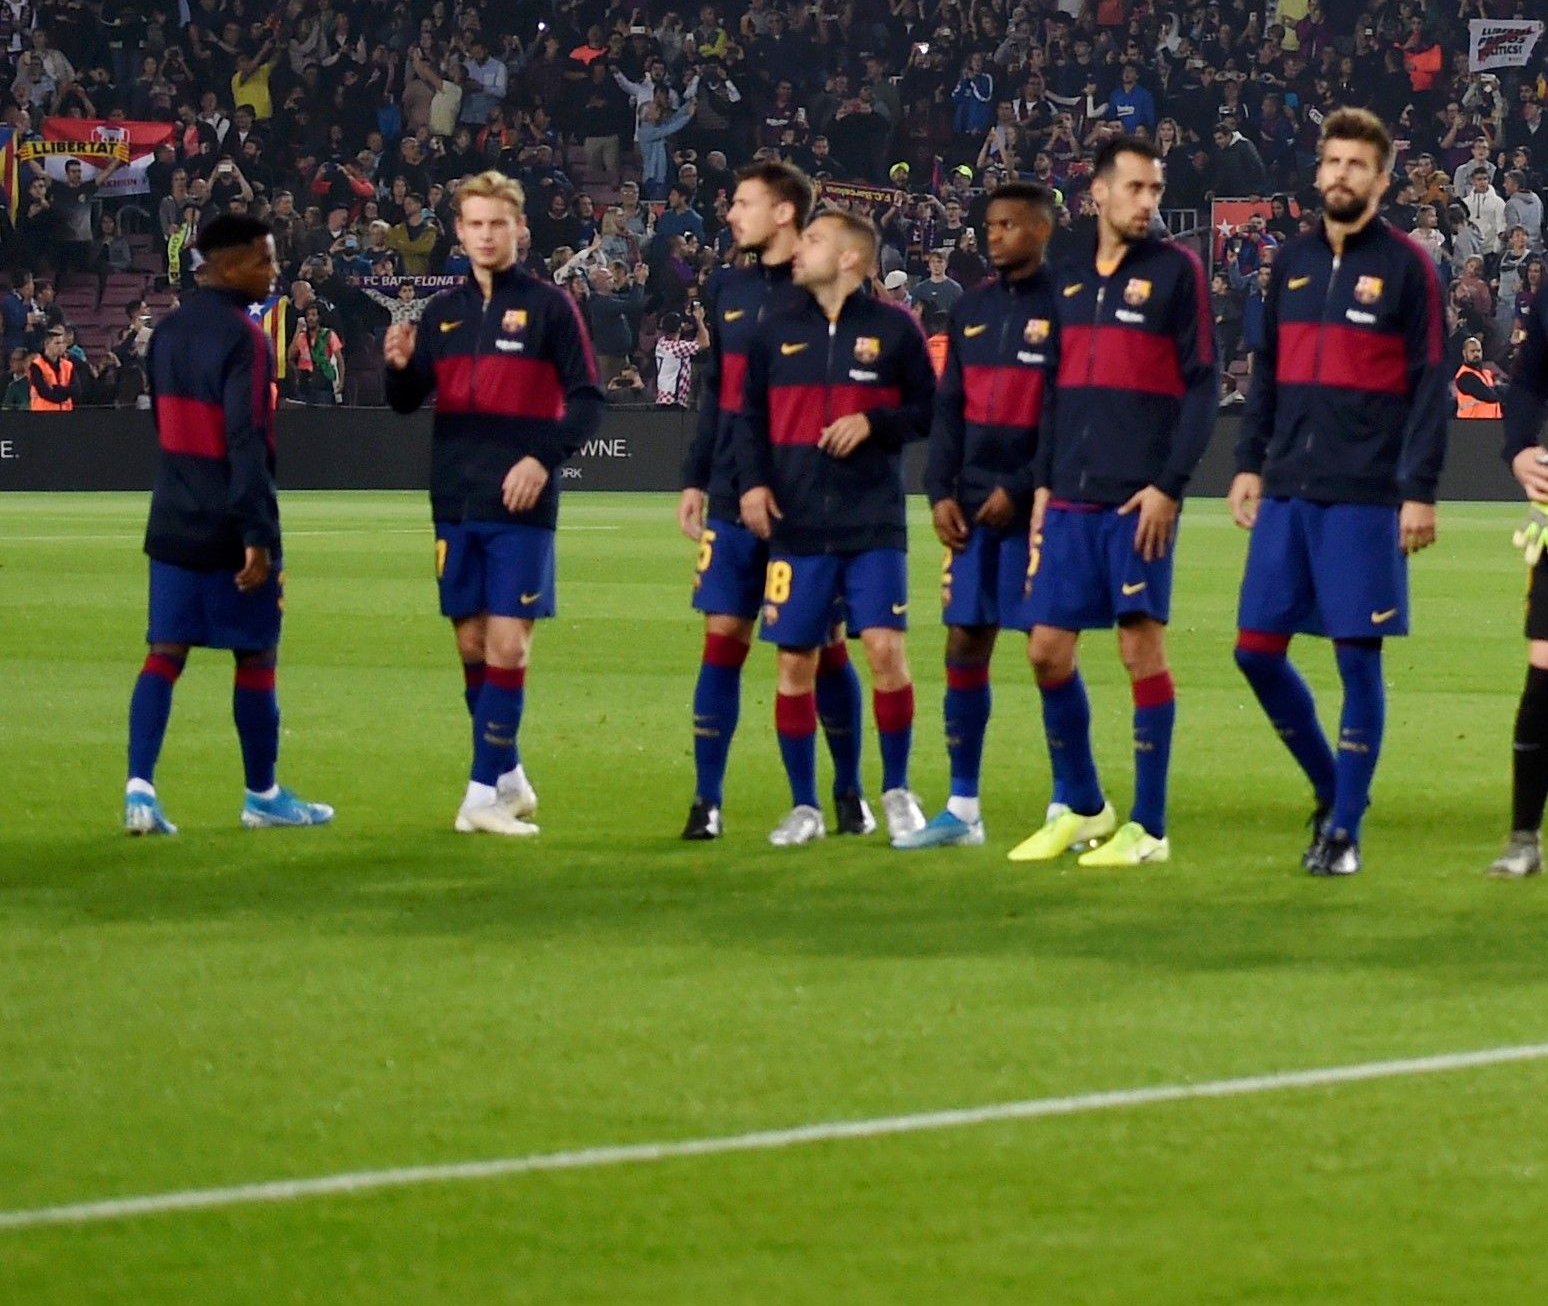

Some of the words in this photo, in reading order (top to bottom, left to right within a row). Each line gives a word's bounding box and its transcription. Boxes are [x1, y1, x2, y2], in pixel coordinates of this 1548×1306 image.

[33, 142, 117, 156] LLIBERTAT
[364, 276, 379, 286] FC
[578, 440, 632, 458] WNE.
